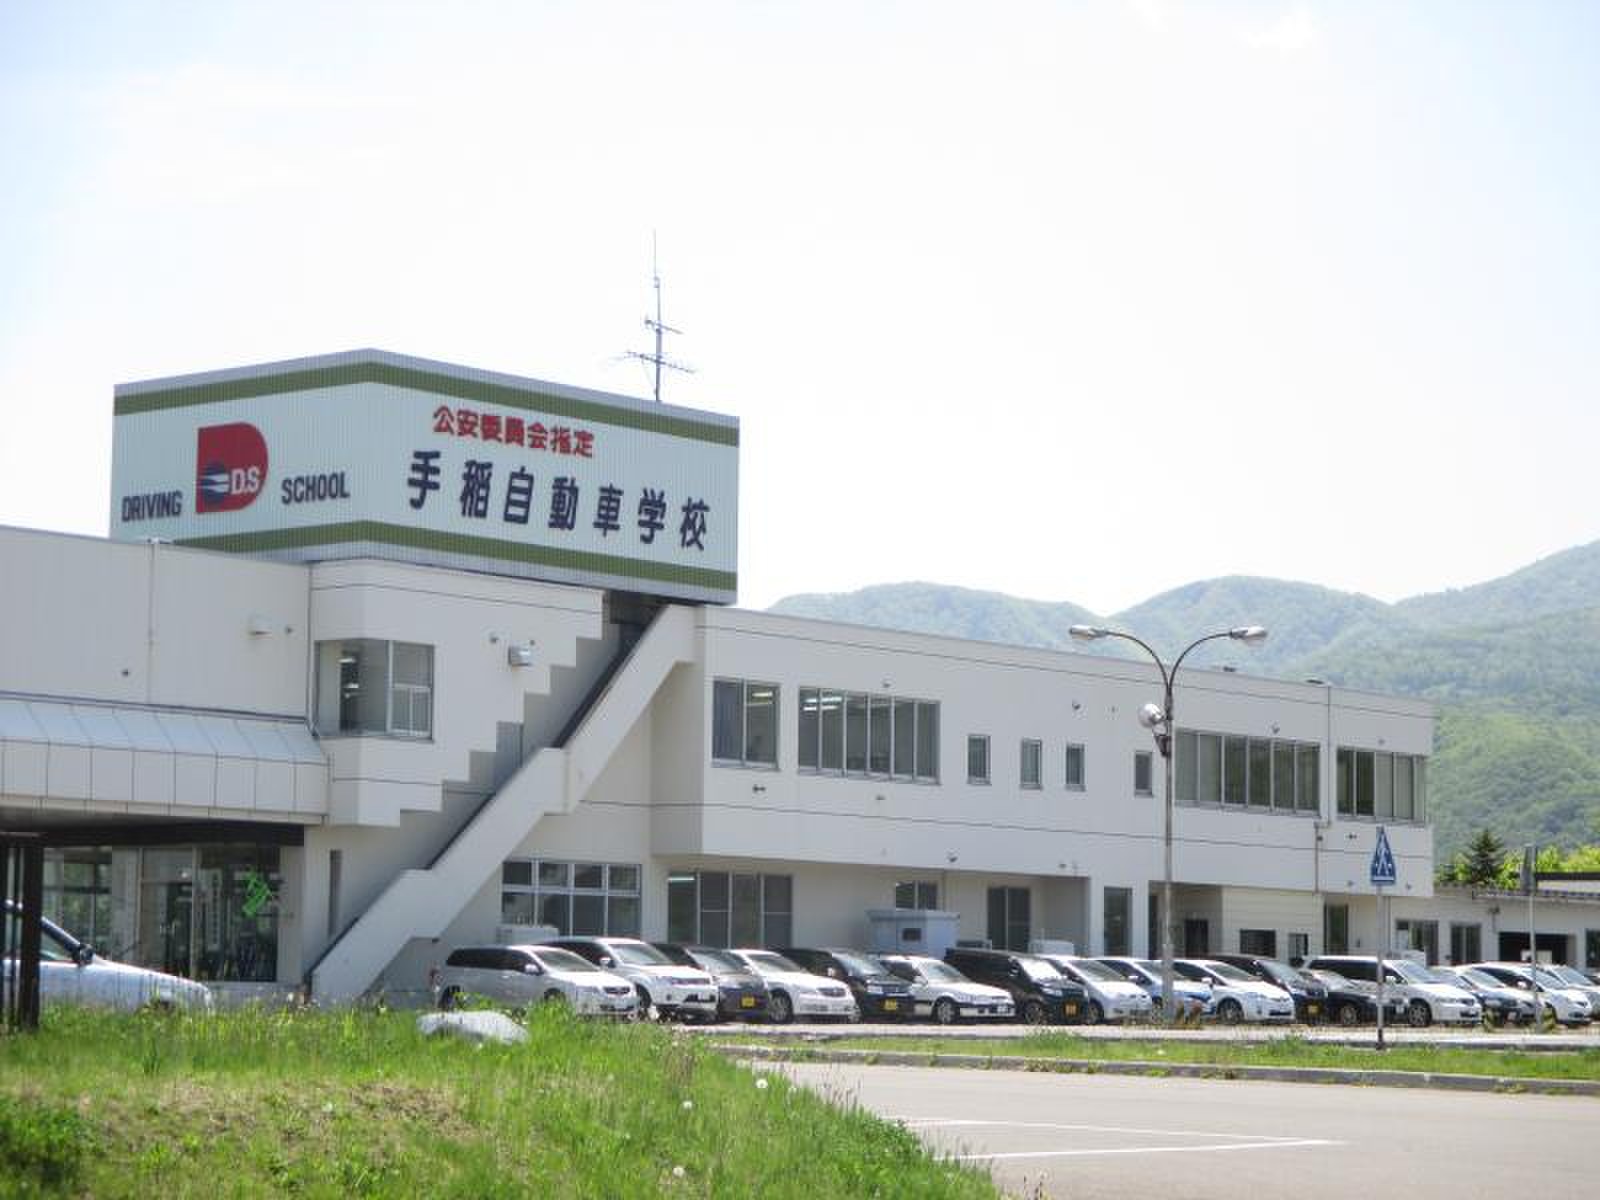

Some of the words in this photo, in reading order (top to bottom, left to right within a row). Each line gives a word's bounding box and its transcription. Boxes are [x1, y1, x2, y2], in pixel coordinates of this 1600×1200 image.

[433, 405, 594, 458] 公安委員会指定
[121, 490, 182, 522] DRIVING
[281, 472, 349, 505] SCHOOL
[407, 451, 710, 550] 手稲自動車学校
